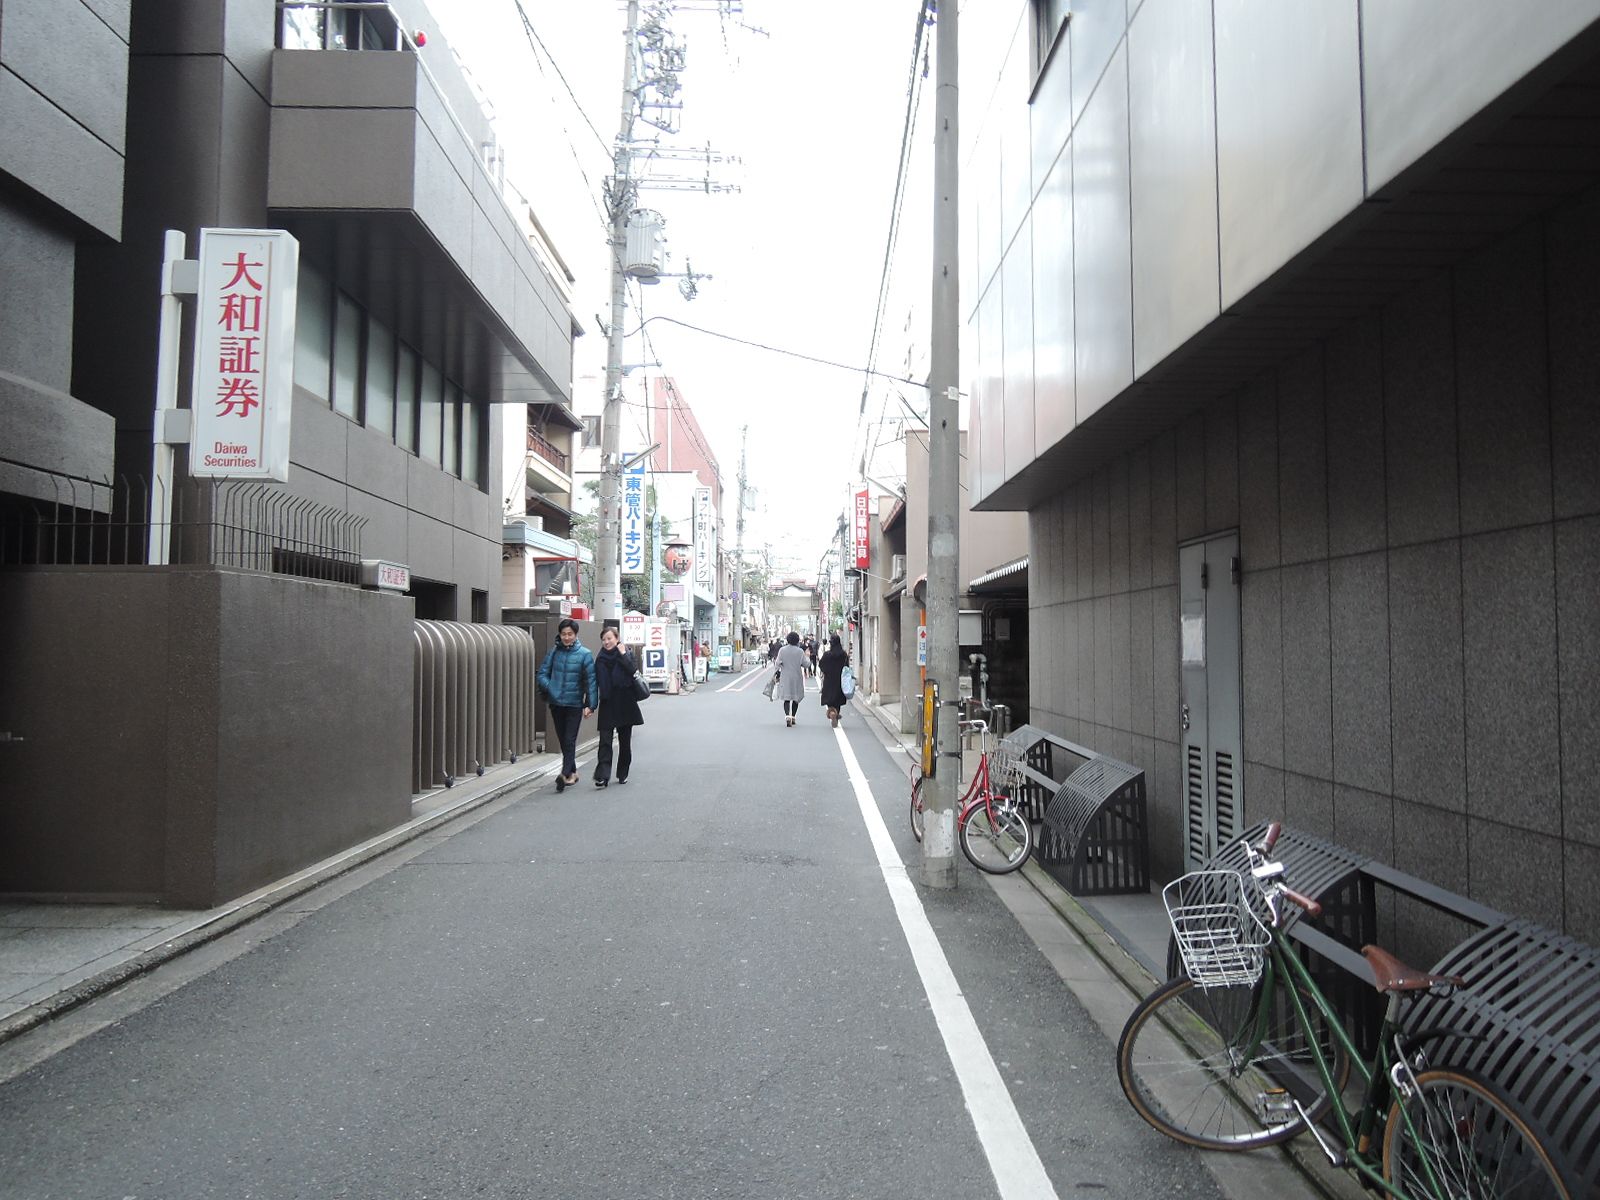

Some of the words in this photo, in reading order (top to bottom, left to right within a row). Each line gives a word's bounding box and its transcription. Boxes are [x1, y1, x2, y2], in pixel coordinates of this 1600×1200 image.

[216, 253, 263, 417] 大和証券
[215, 442, 247, 454] Daiwa
[204, 455, 257, 467] Securities
[625, 476, 641, 570] 東管パーキング
[650, 652, 661, 666] P
